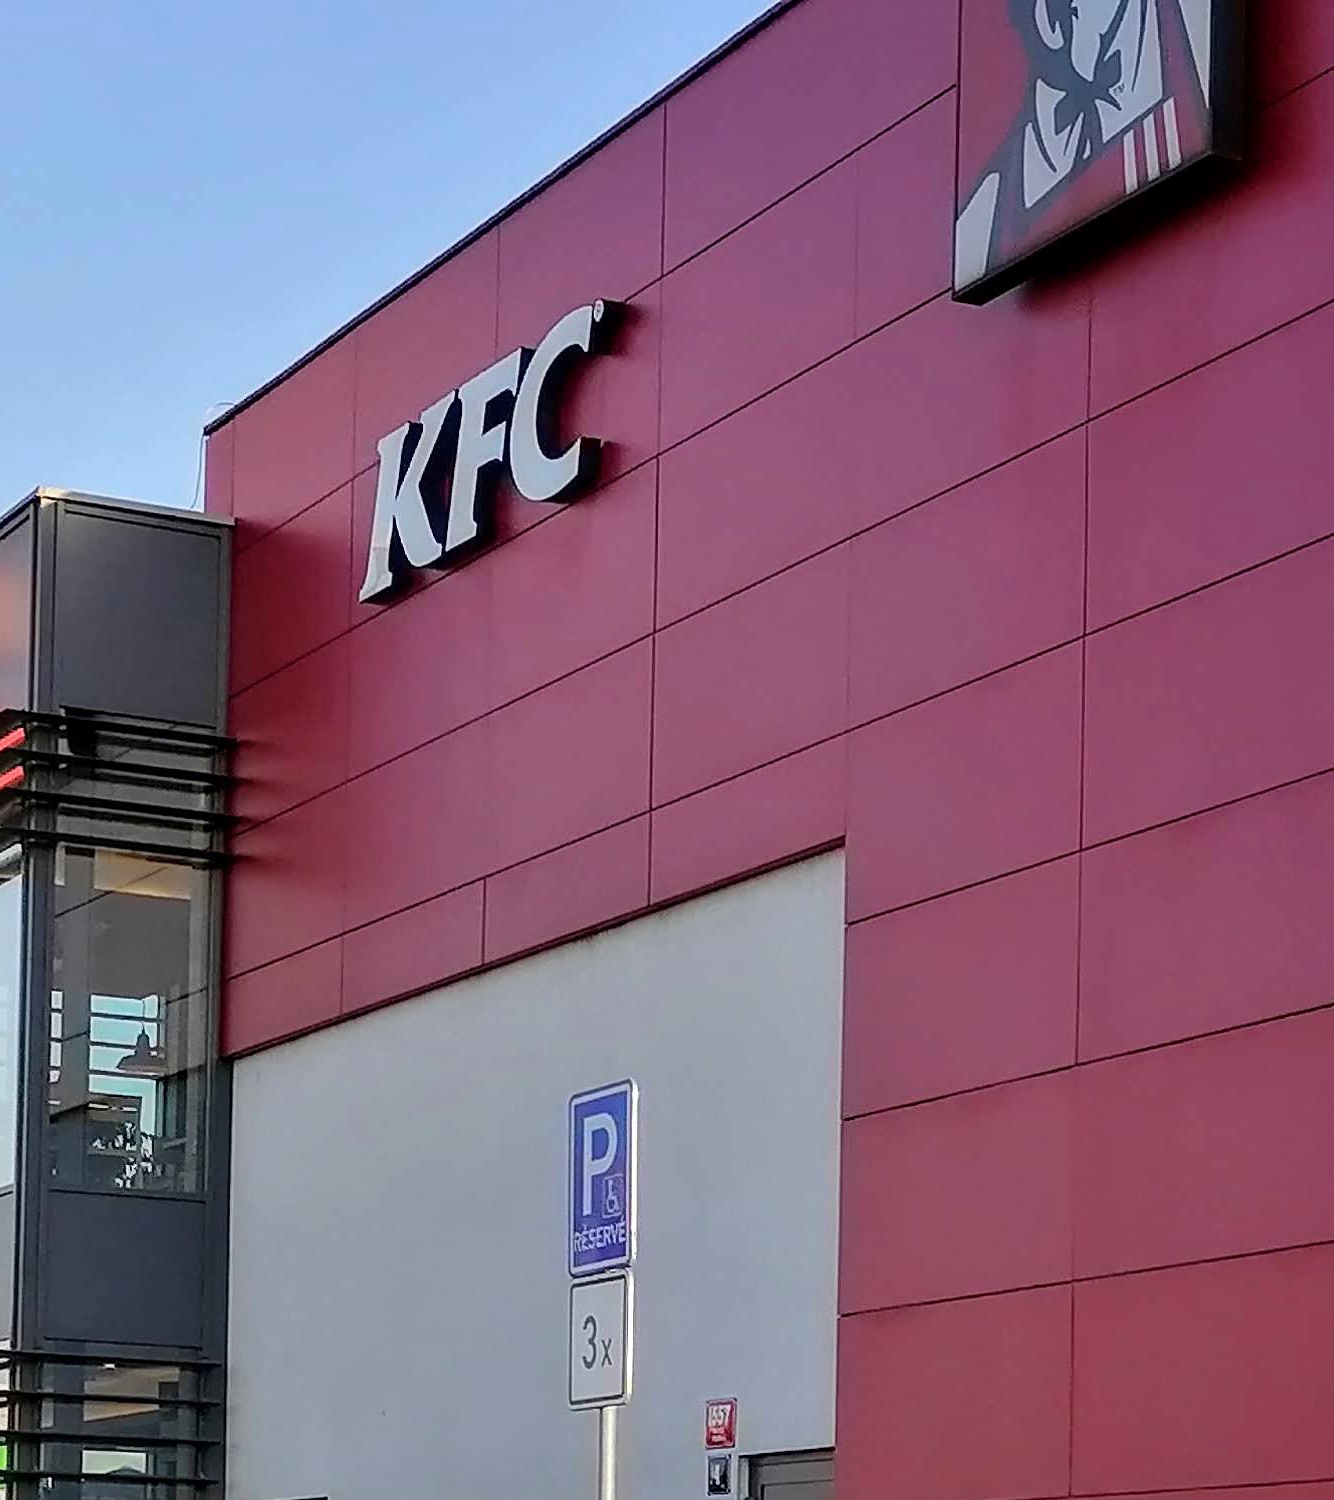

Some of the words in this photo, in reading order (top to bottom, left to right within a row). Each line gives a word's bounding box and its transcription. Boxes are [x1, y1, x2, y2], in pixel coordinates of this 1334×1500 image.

[359, 303, 594, 603] KFC
[582, 1112, 619, 1217] P
[582, 1315, 612, 1369] 3x
